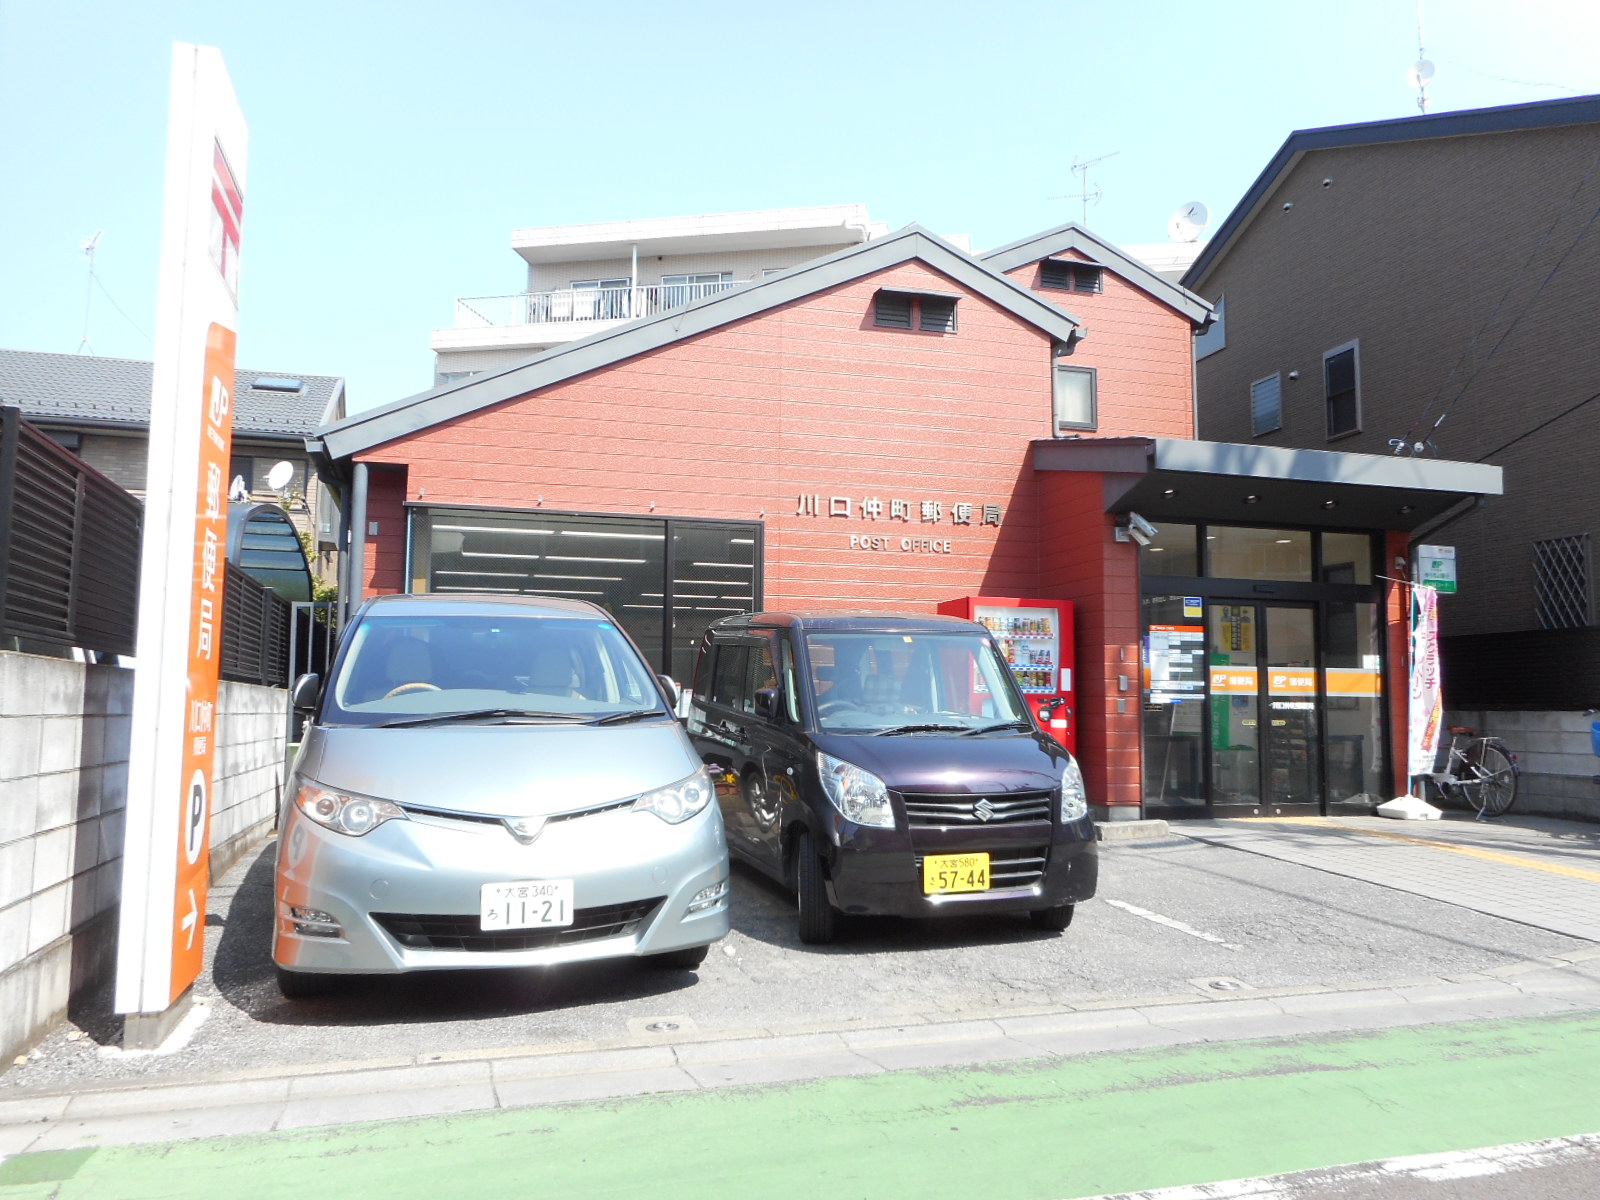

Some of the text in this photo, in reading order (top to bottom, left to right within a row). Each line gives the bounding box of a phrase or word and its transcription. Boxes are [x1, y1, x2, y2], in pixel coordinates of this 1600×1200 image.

[796, 493, 1002, 527] 川口仲町郵便局
[850, 535, 951, 554] POST OFFICE
[197, 461, 221, 660] 郵便局
[189, 783, 204, 852] P
[504, 885, 554, 899] 大宮340
[938, 869, 986, 889] 57-44
[487, 899, 564, 925] ろ 11-21
